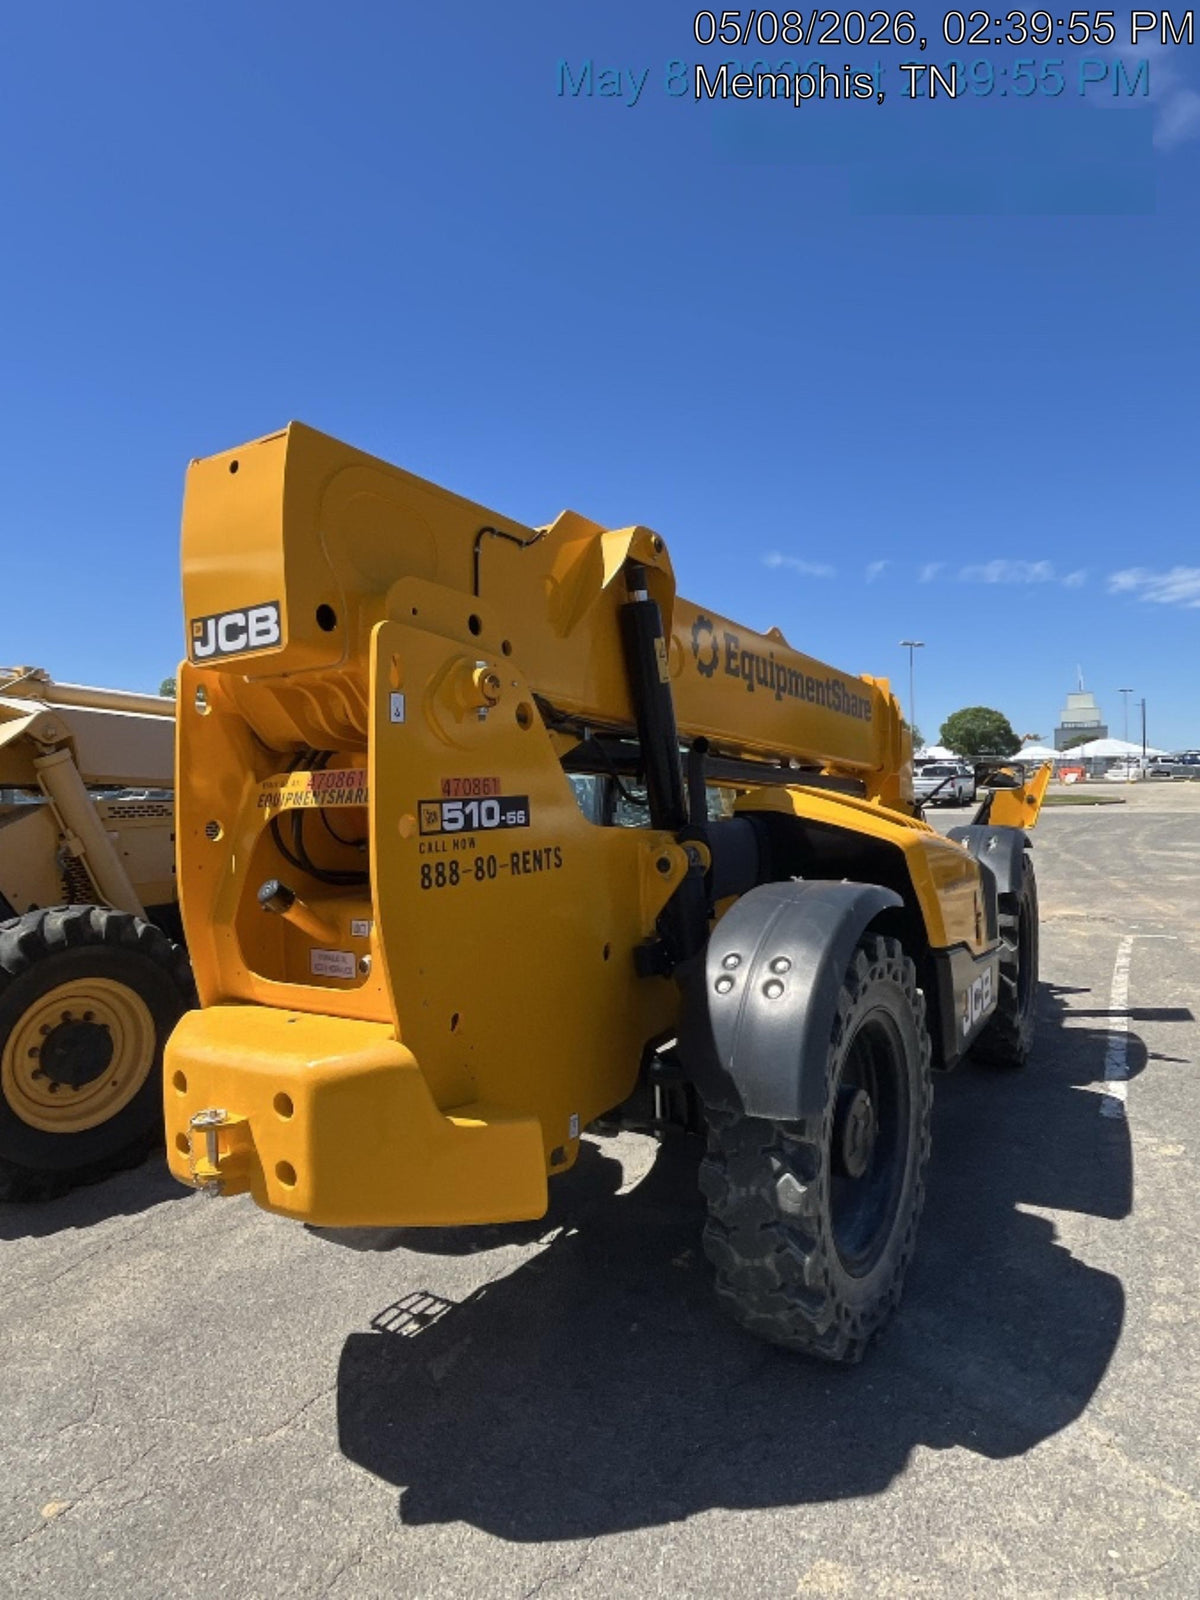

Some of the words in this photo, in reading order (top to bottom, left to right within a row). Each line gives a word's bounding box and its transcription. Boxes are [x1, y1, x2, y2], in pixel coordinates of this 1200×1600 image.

[193, 606, 280, 657] JCB
[723, 632, 872, 722] EquipmentShare
[307, 770, 365, 790] 470861
[441, 777, 499, 797] 470861
[257, 786, 369, 808] EQUIPMENTSHAR
[419, 841, 447, 854] CALL
[452, 837, 476, 849] NOW
[420, 846, 563, 890] 888-80-RENTS
[963, 966, 992, 1037] JCB
